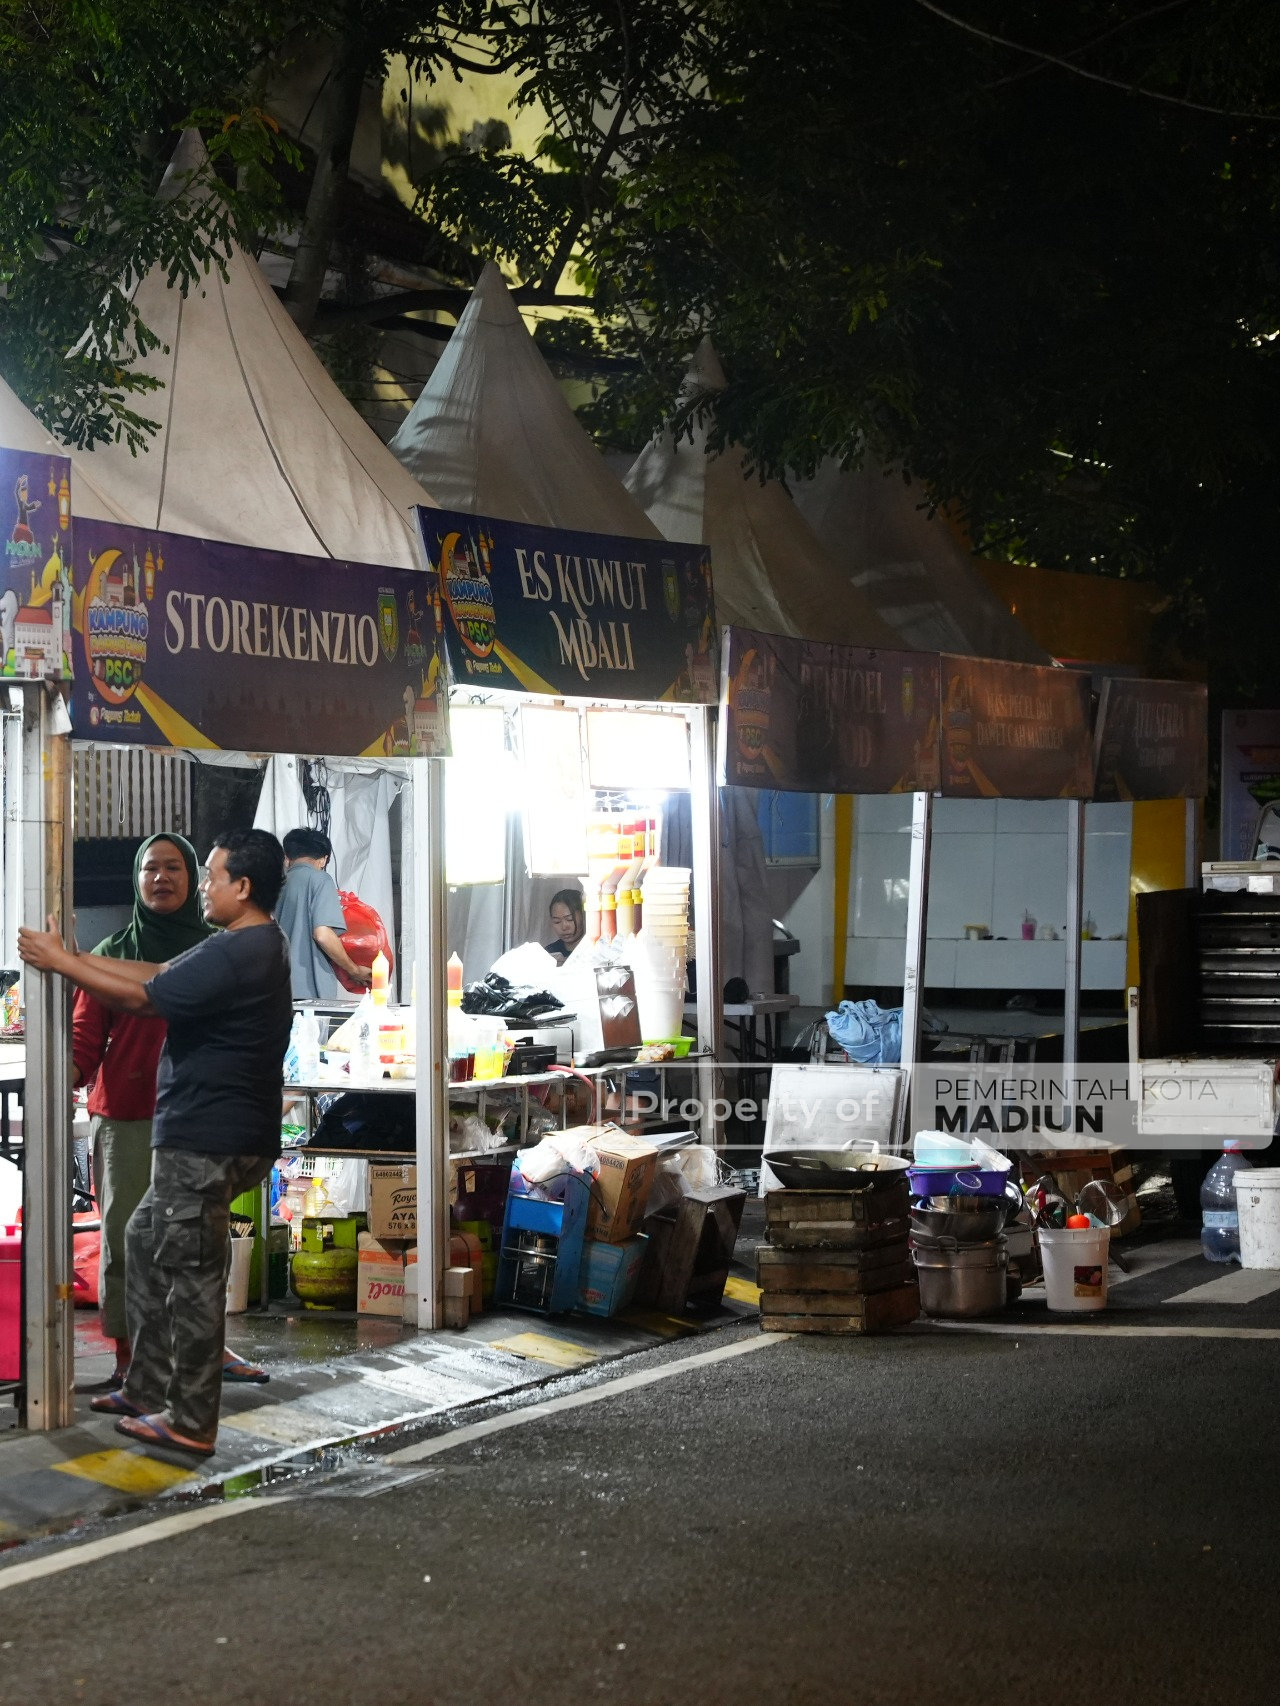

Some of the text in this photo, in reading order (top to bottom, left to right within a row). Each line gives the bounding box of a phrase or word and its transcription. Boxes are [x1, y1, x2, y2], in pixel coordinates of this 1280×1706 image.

[514, 548, 648, 620] ES KUWUT
[88, 606, 149, 640] KAMPUNG
[164, 590, 379, 667] STOREKENZIO
[466, 620, 490, 642] PSC
[549, 610, 635, 681] MBALI
[106, 660, 132, 685] PSC
[392, 1193, 417, 1206] Royc
[388, 1222, 402, 1230] 576
[392, 1212, 417, 1221] AYA
[368, 1282, 405, 1300] moli
